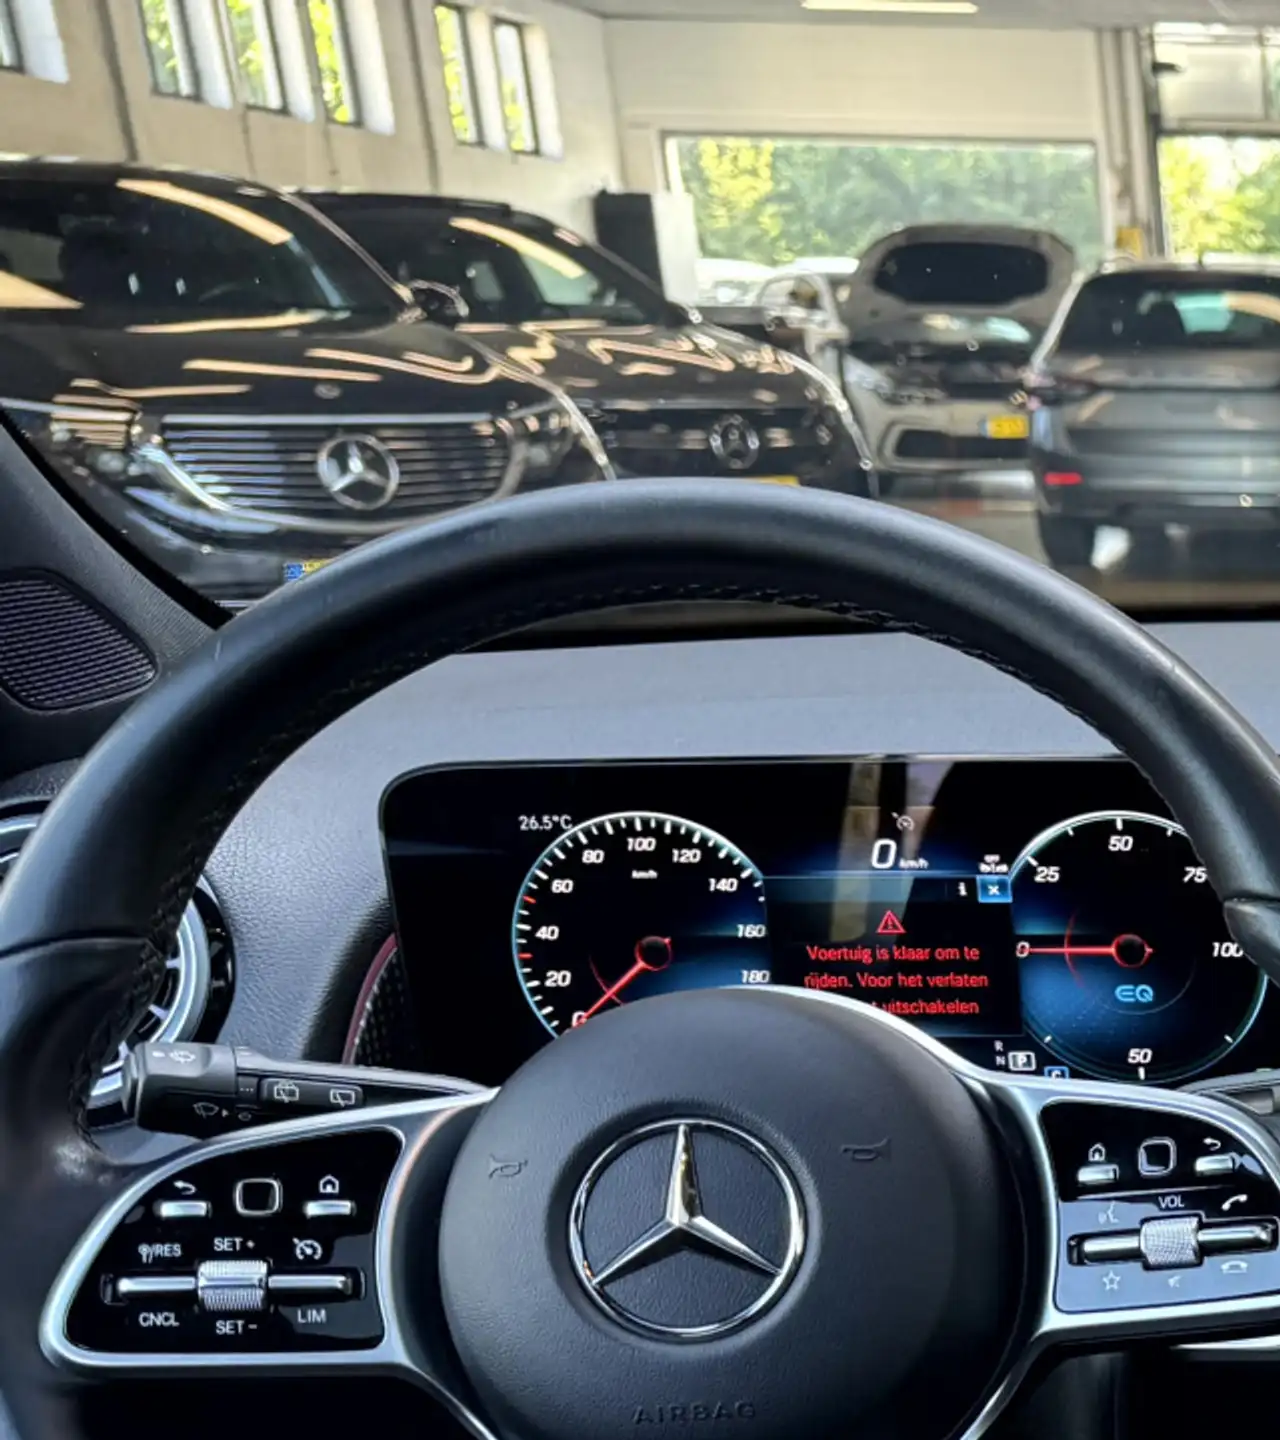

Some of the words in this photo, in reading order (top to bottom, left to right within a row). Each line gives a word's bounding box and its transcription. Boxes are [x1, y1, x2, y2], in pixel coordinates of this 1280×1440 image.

[519, 815, 573, 831] 26.5°C
[627, 837, 656, 851] 100
[1108, 836, 1133, 851] 50
[582, 850, 604, 863] 80
[672, 849, 701, 863] 120
[871, 838, 897, 869] 0
[1034, 866, 1060, 883] 25
[1183, 867, 1208, 883] 75
[551, 879, 574, 893] 60
[708, 878, 738, 892] 140
[534, 926, 559, 939] 40
[806, 945, 873, 964] Voertuig
[875, 945, 890, 960] is
[893, 945, 930, 960] klaar
[935, 948, 960, 960] om
[963, 947, 980, 960] te
[1016, 942, 1030, 958] 0
[1212, 943, 1244, 958] 100
[544, 971, 572, 987] 20
[741, 969, 770, 984] 180
[804, 972, 853, 989] rijden.
[856, 972, 894, 988] Voor
[898, 973, 924, 988] het
[926, 973, 989, 988] verlaten
[1114, 985, 1154, 1003] EQ
[1017, 1055, 1028, 1066] P
[1127, 1048, 1152, 1064] 50
[1159, 1195, 1185, 1208] VOL
[213, 1238, 243, 1251] SET
[138, 1311, 180, 1327] CNCL
[297, 1310, 327, 1323] LIM
[215, 1320, 244, 1334] SET
[632, 1402, 756, 1425] AIRBAG
